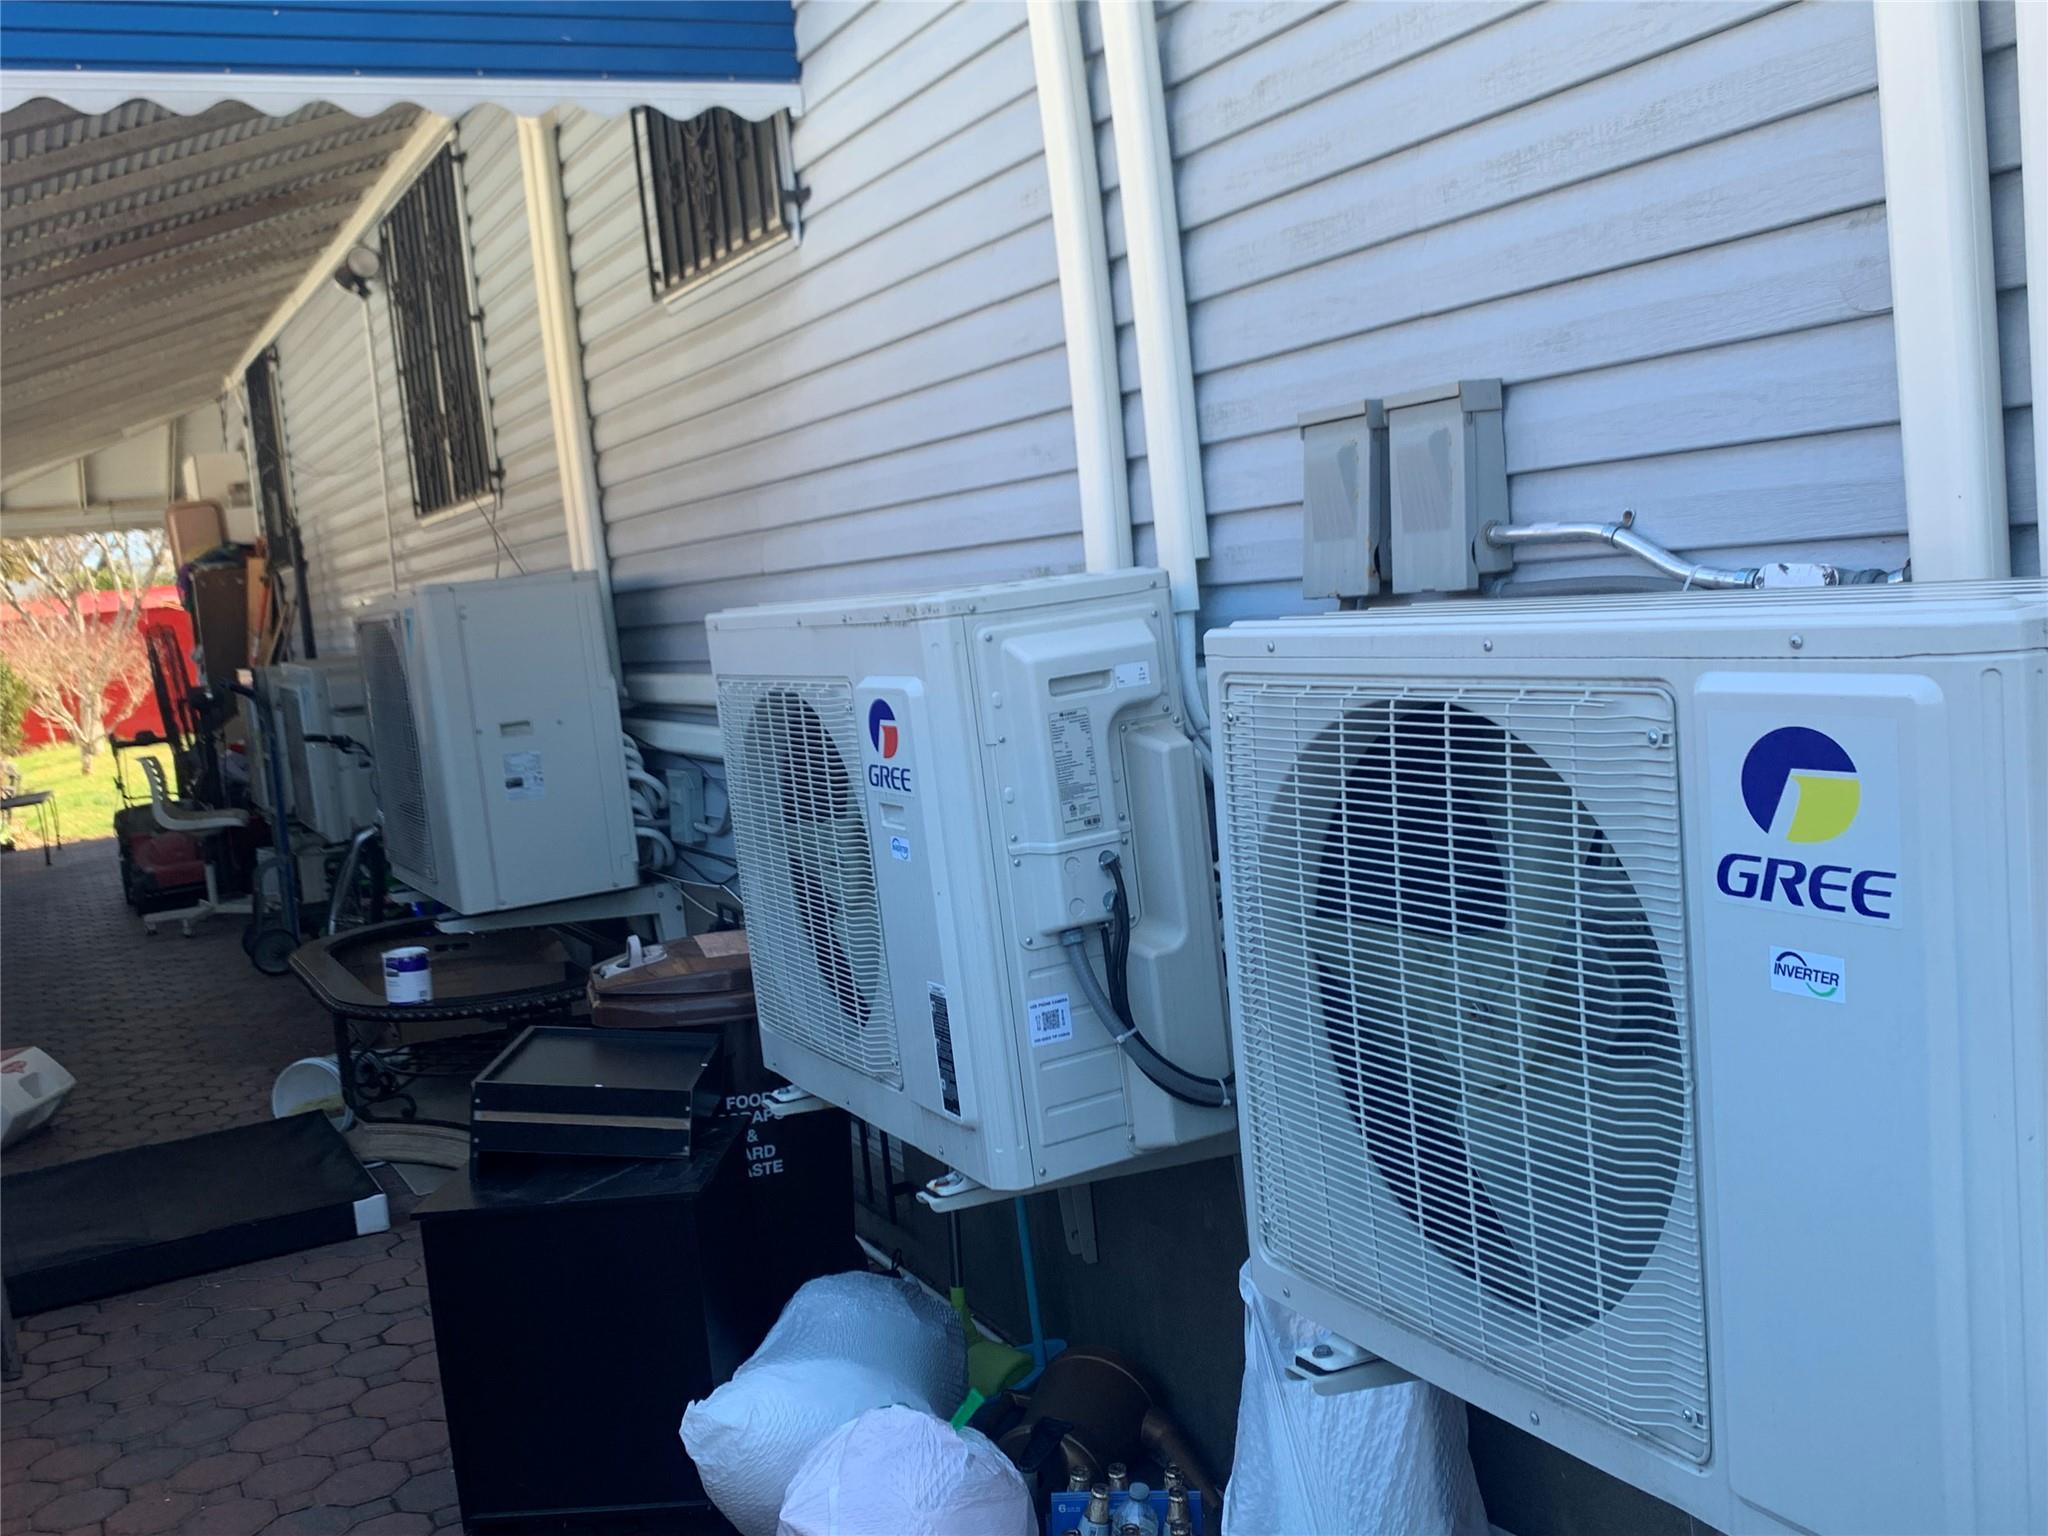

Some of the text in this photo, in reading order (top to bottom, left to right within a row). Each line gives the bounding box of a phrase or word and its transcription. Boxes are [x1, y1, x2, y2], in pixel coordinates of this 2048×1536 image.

[868, 763, 912, 793] GREE
[1716, 852, 1897, 920] GREE
[1773, 962, 1840, 987] INVERTER
[747, 1129, 759, 1142] &
[746, 1144, 777, 1161] RD
[748, 1159, 784, 1178] STE
